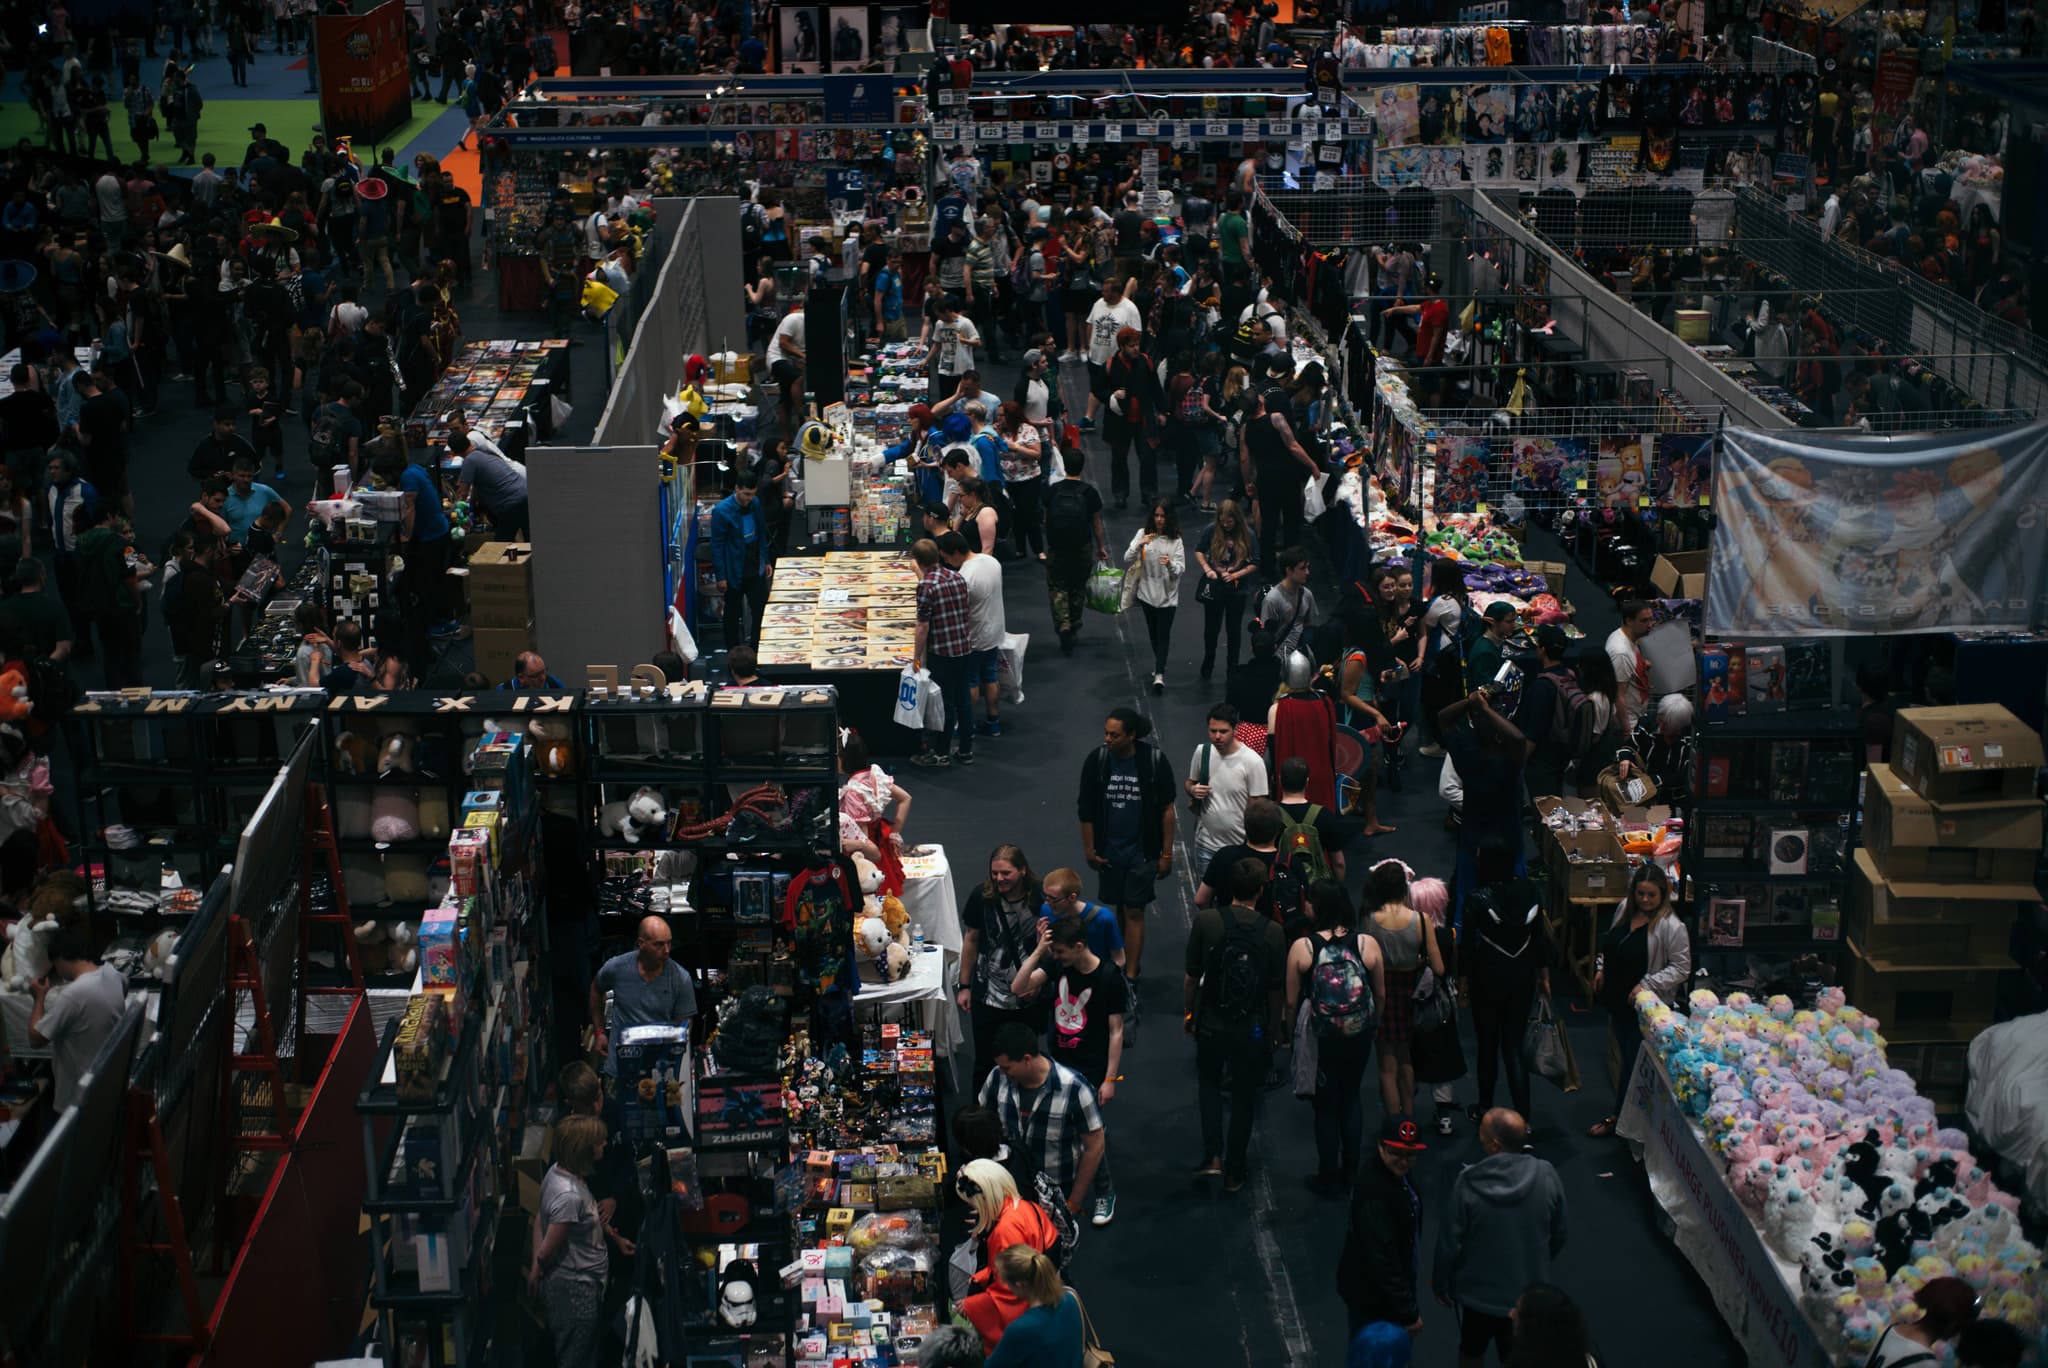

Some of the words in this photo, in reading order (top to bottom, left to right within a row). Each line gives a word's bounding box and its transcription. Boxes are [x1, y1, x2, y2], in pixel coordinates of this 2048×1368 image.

[900, 682, 917, 706] DC
[712, 1131, 773, 1144] ZEKROM
[1659, 1119, 1675, 1152] ALL
[1675, 1150, 1703, 1202] LARGE
[1703, 1198, 1746, 1276] PLUSHIES
